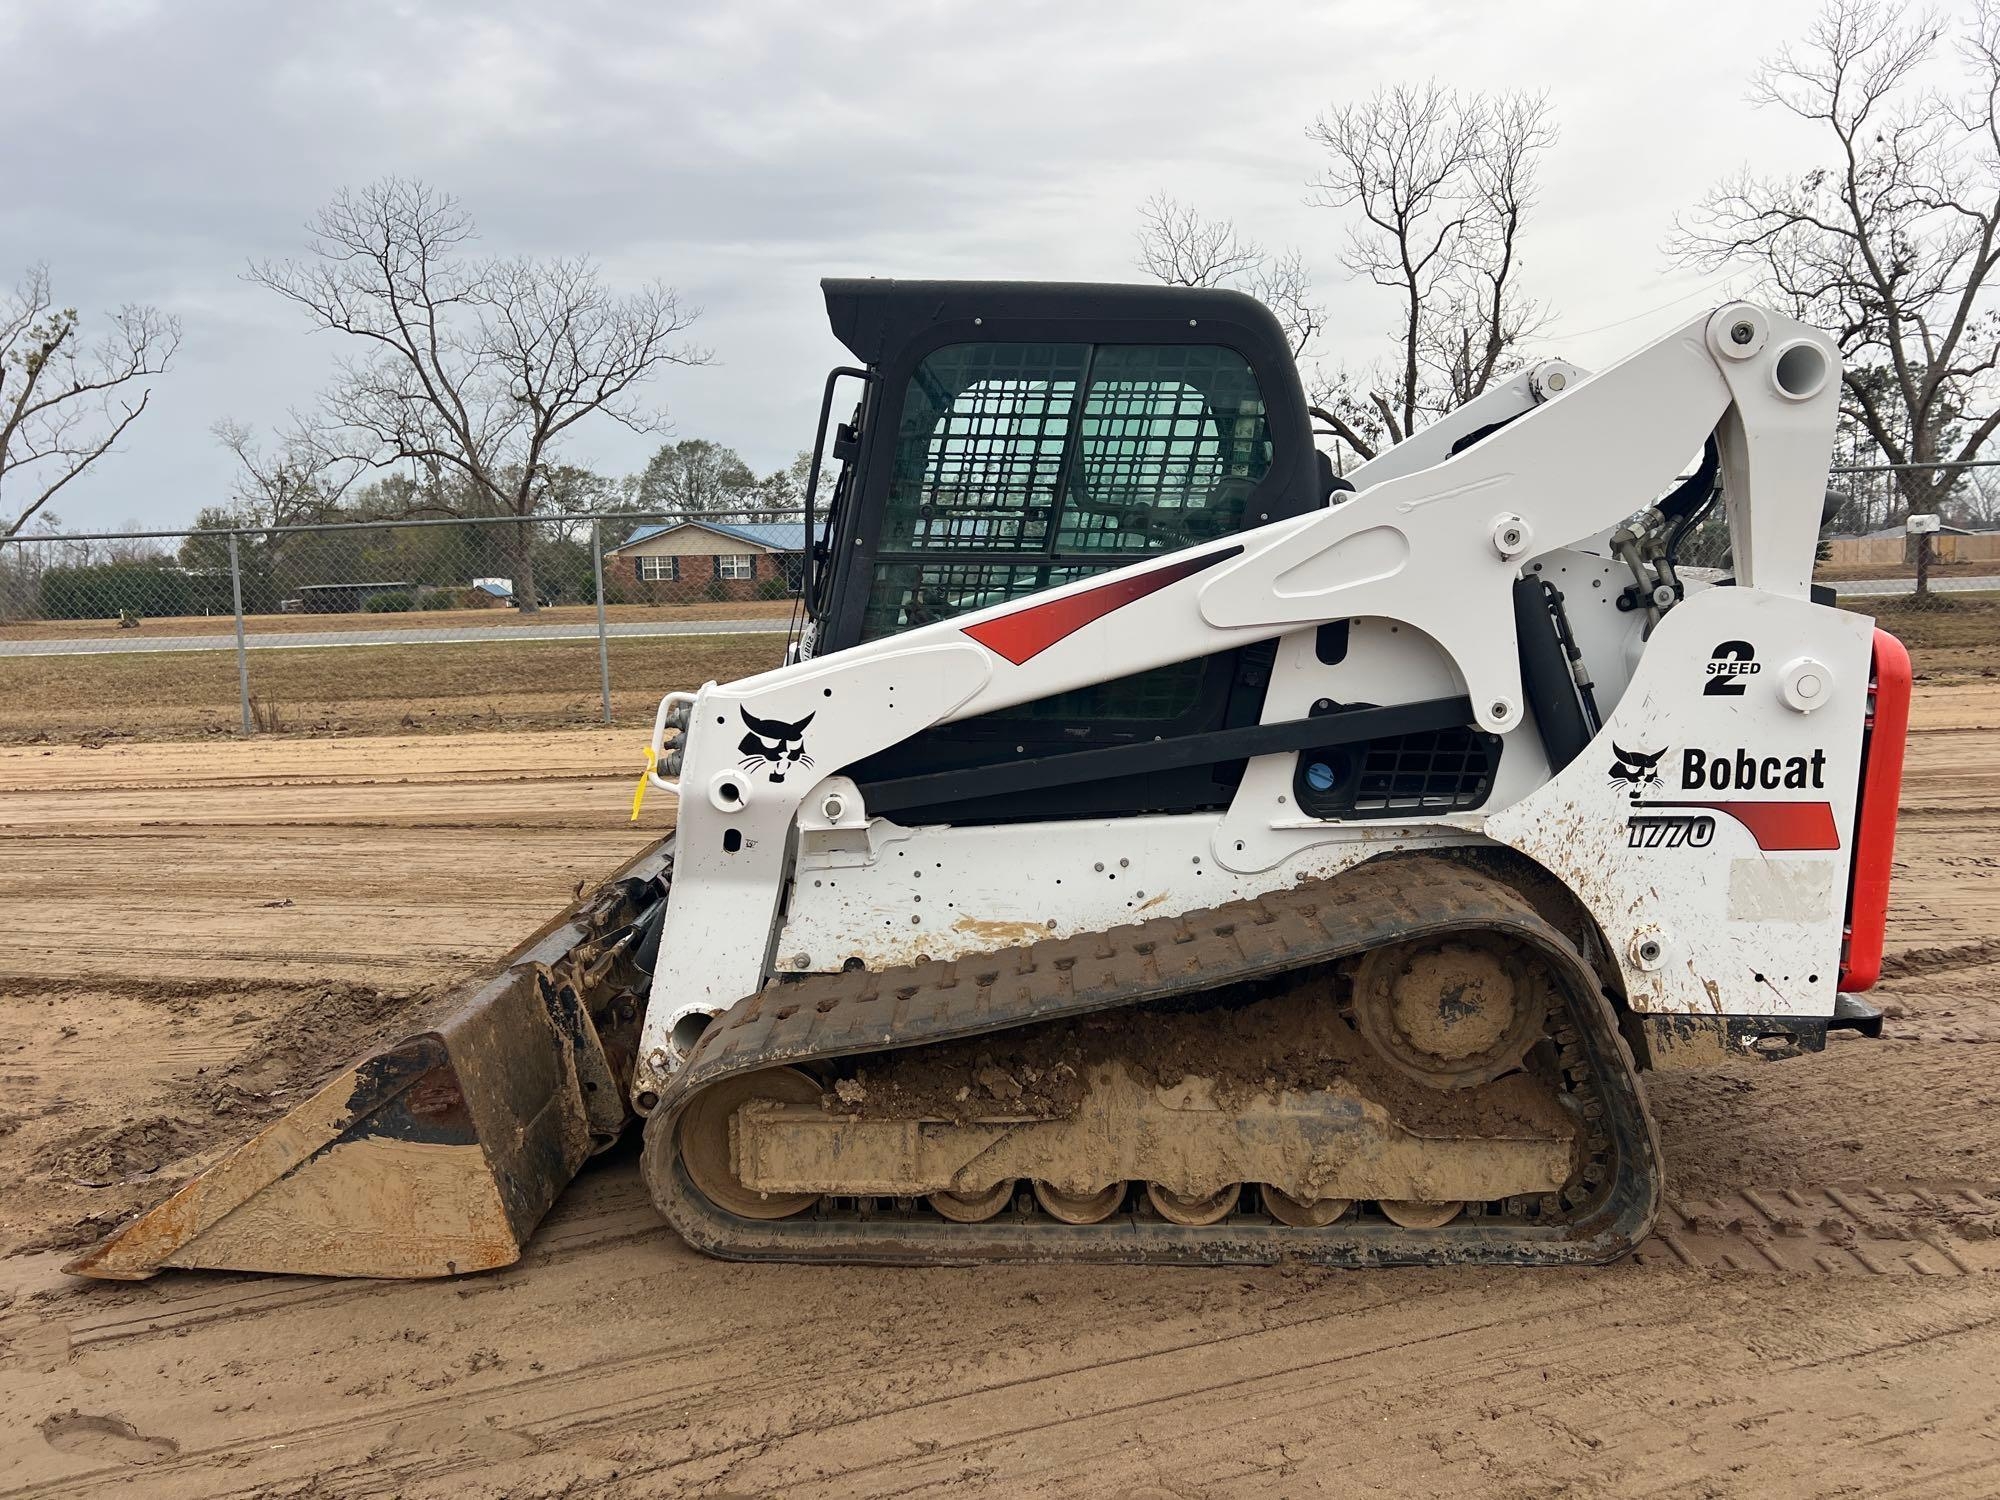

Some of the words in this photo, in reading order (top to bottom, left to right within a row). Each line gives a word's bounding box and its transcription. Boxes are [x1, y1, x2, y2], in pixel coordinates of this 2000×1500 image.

[804, 636, 814, 661] 2081
[1703, 640, 1755, 695] 2
[1706, 662, 1761, 675] SPEED
[1682, 748, 1826, 790] Bobcat
[1627, 815, 1716, 848] T770
